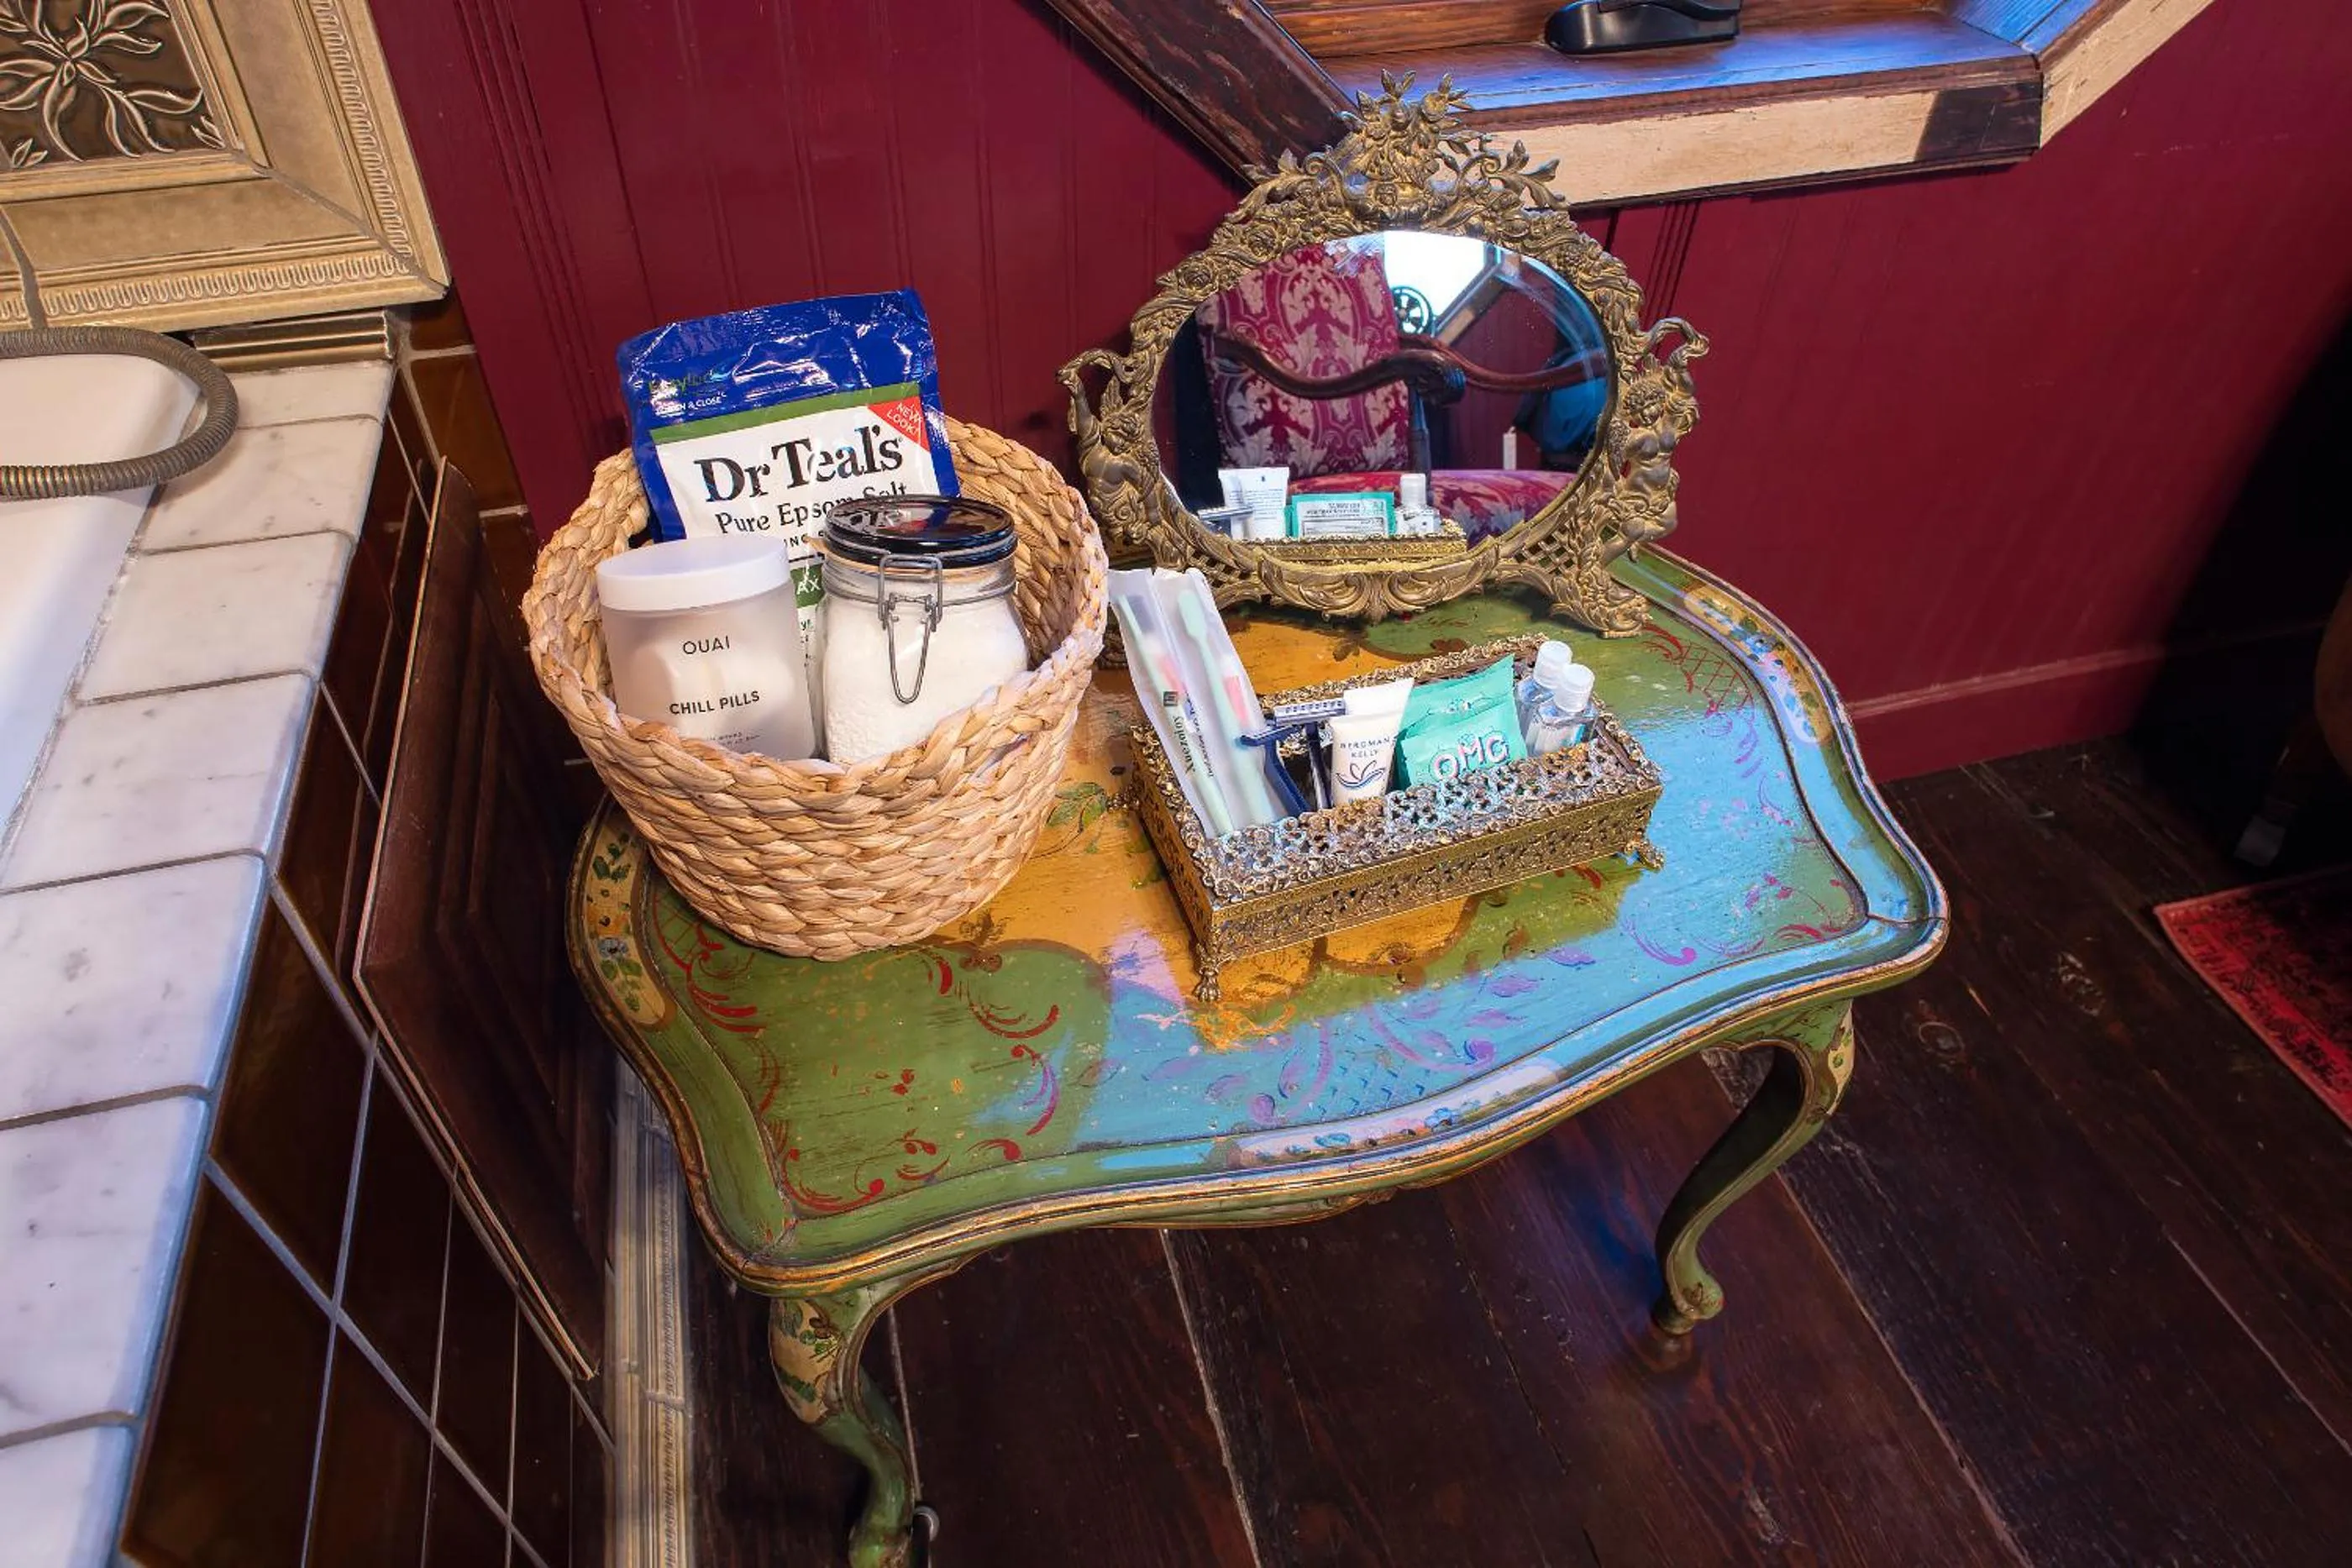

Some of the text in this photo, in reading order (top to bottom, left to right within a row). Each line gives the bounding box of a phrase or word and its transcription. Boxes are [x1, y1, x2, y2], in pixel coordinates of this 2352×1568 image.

[696, 396, 723, 407] CLOSE
[896, 402, 921, 423] NEW
[694, 425, 903, 502] Dr Teal's
[715, 511, 770, 534] Pure
[683, 635, 730, 654] OUAI
[669, 690, 760, 715] CHILL PILLS
[1340, 736, 1390, 748] BERGMAN
[1351, 749, 1378, 758] KELLY
[1431, 731, 1510, 780] OMG
